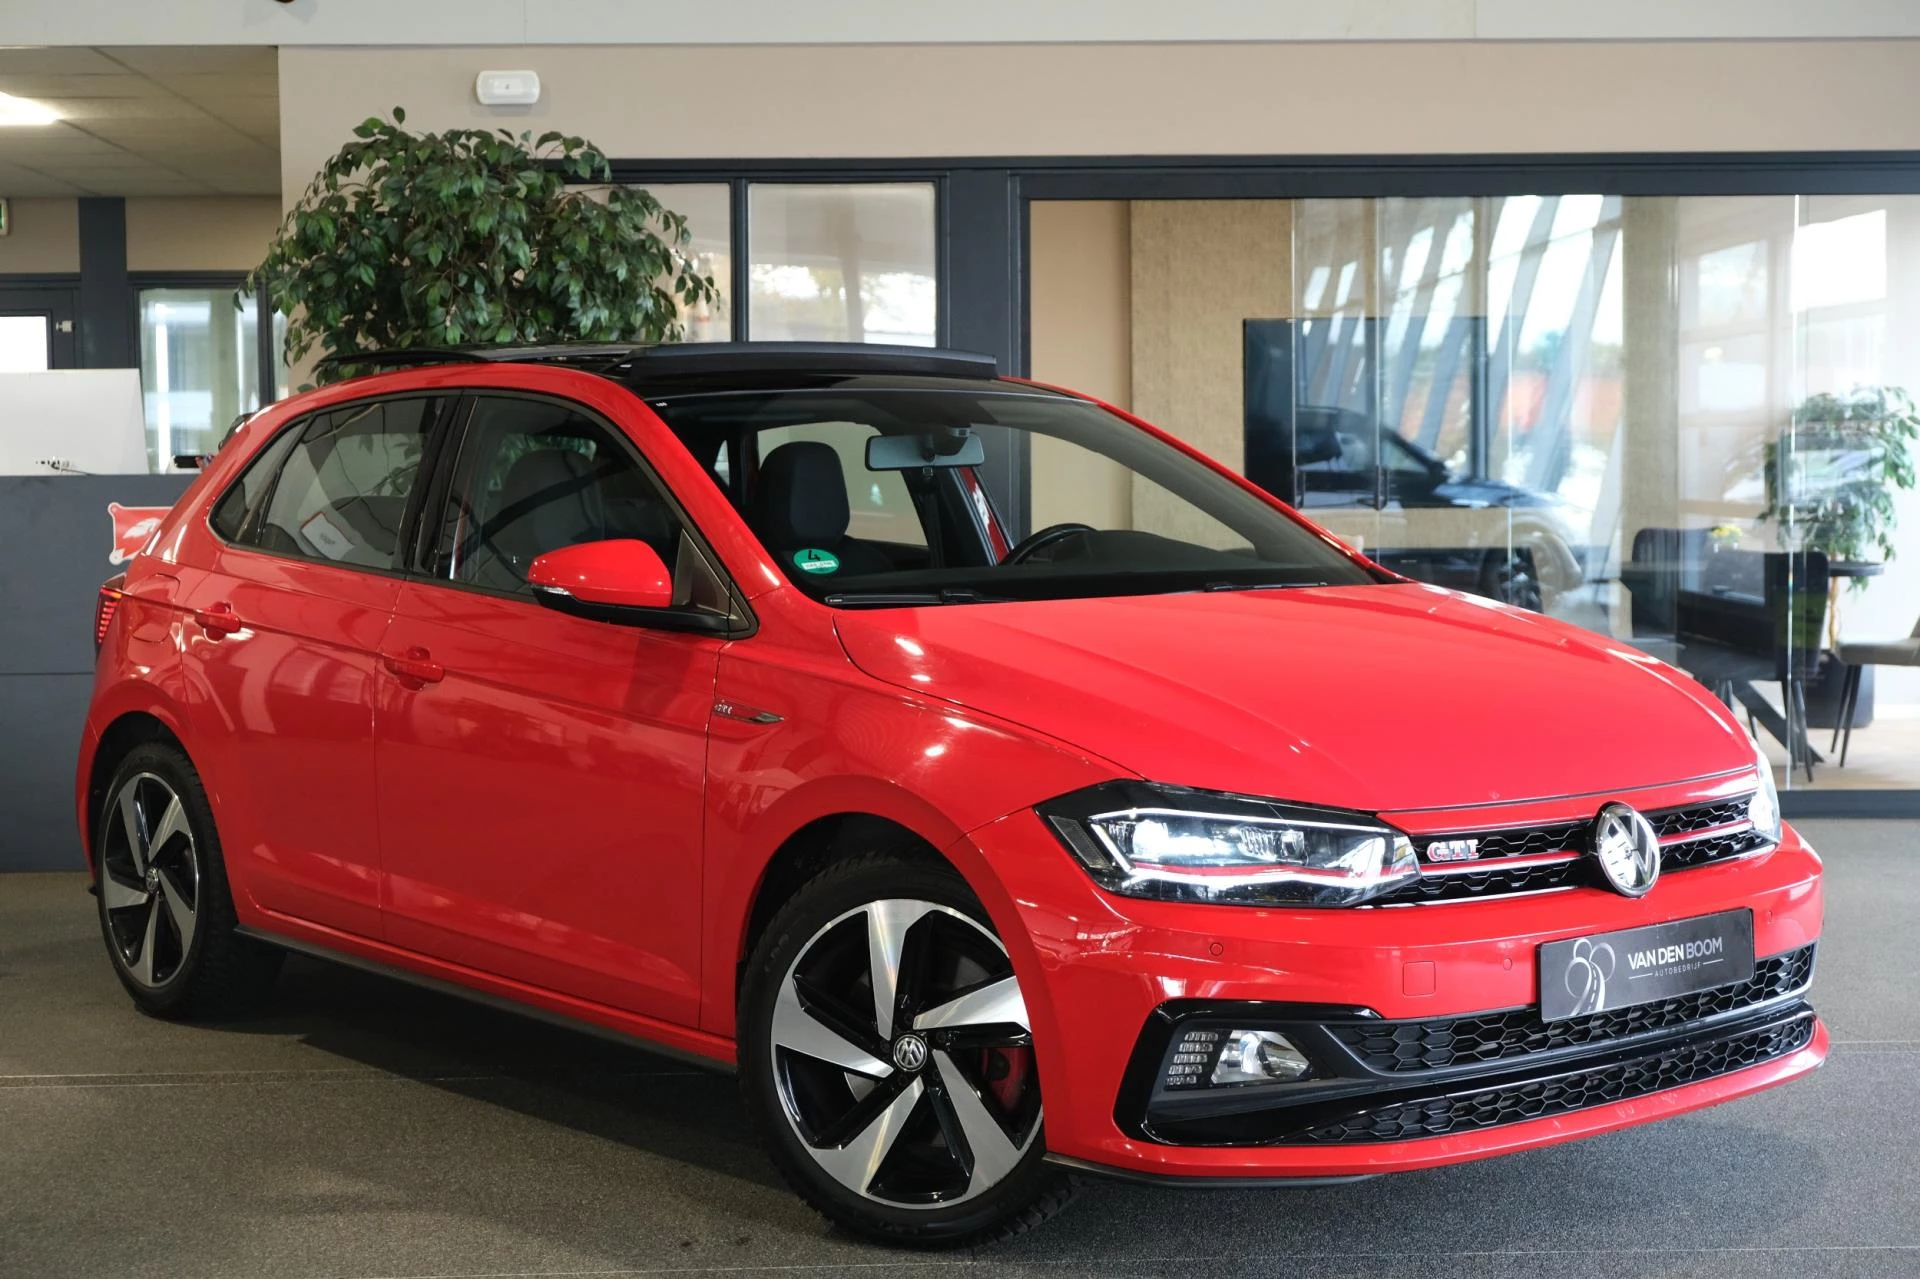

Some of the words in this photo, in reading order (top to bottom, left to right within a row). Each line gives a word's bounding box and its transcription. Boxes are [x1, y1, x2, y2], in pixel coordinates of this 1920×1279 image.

[1427, 839, 1479, 862] GTI
[1627, 949, 1657, 970] VAN
[1658, 944, 1685, 965] DEN
[1686, 936, 1723, 959] BOOM
[1654, 962, 1701, 977] AUTOBEDRIJF
